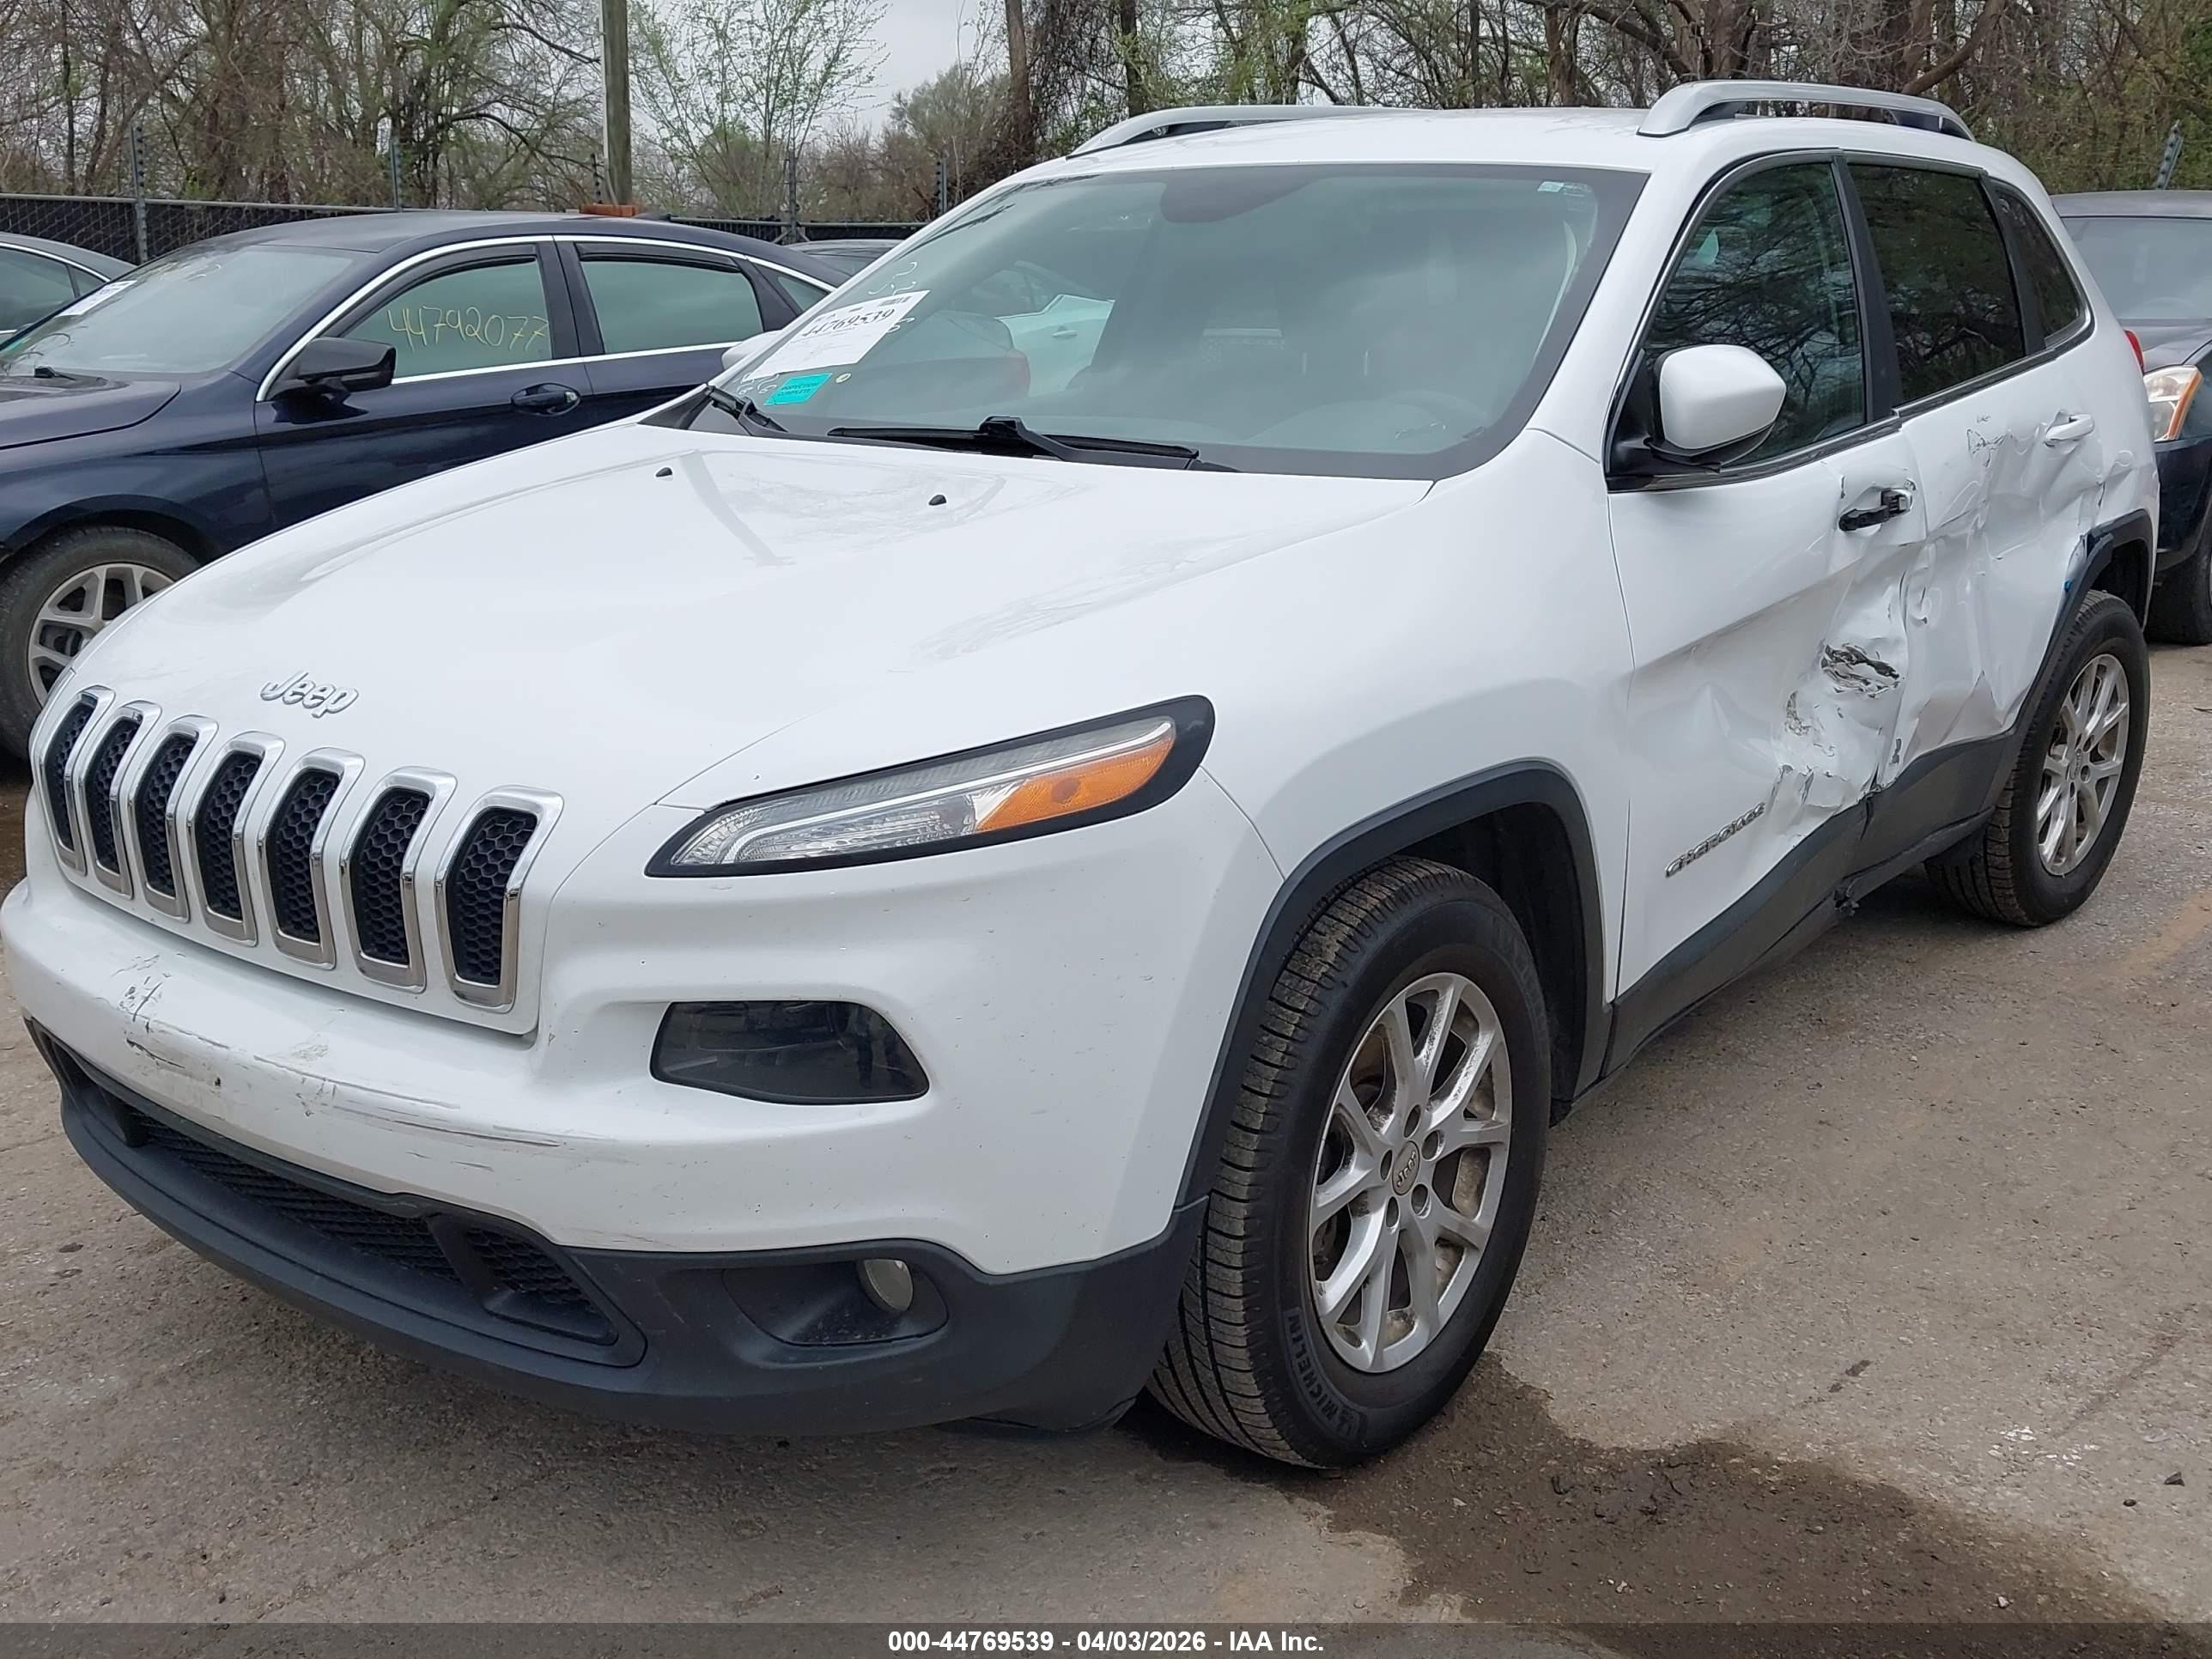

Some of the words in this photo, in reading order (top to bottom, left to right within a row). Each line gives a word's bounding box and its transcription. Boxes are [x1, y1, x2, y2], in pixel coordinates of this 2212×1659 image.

[387, 305, 550, 352] 44792077
[259, 670, 359, 719] Jeep
[1288, 1316, 1339, 1420] MICHELIN
